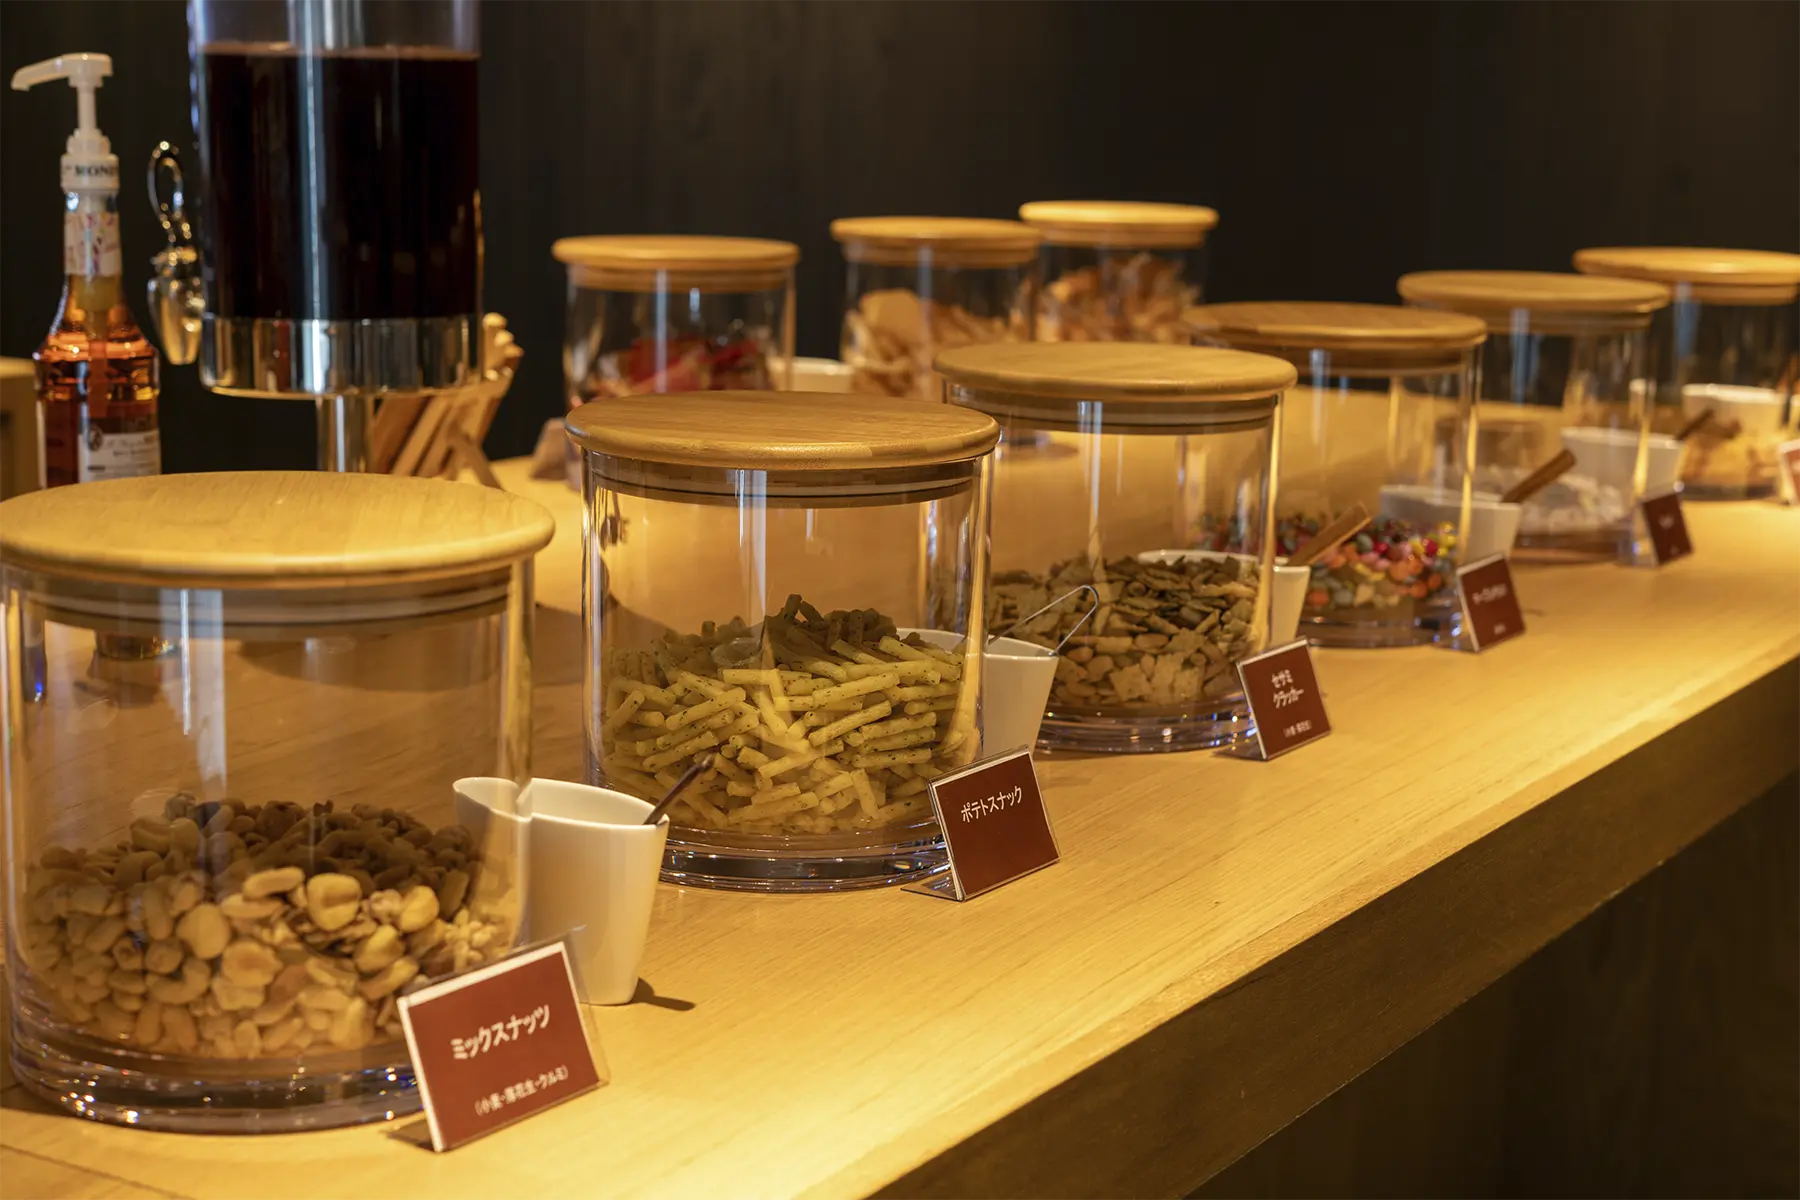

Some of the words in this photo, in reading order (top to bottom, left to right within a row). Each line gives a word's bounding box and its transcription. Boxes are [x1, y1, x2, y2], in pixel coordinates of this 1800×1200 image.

[960, 785, 1022, 823] ポテトスナック
[450, 1004, 550, 1060] ミックスナッツ
